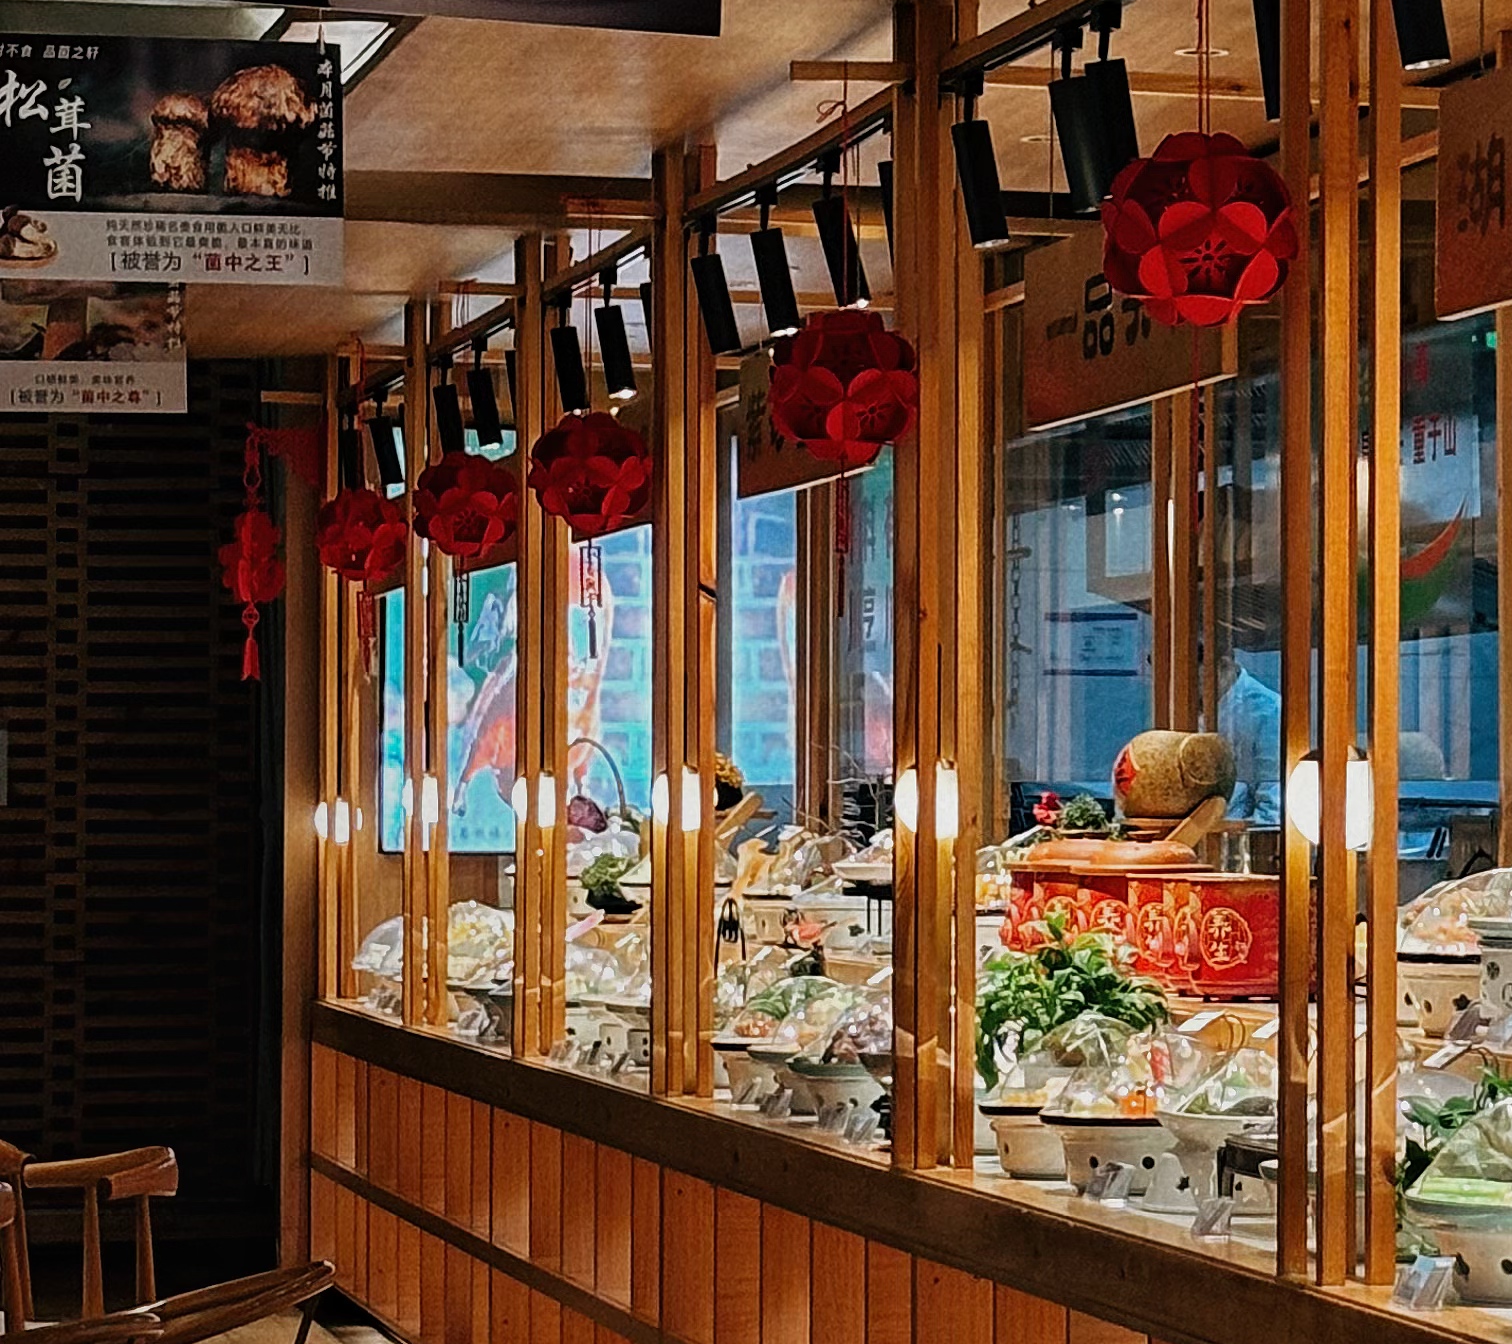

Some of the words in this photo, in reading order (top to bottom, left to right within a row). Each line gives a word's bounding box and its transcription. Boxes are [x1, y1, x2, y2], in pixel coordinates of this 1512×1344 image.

[0, 69, 92, 203] 松茸菌
[1046, 272, 1151, 360] 一品
